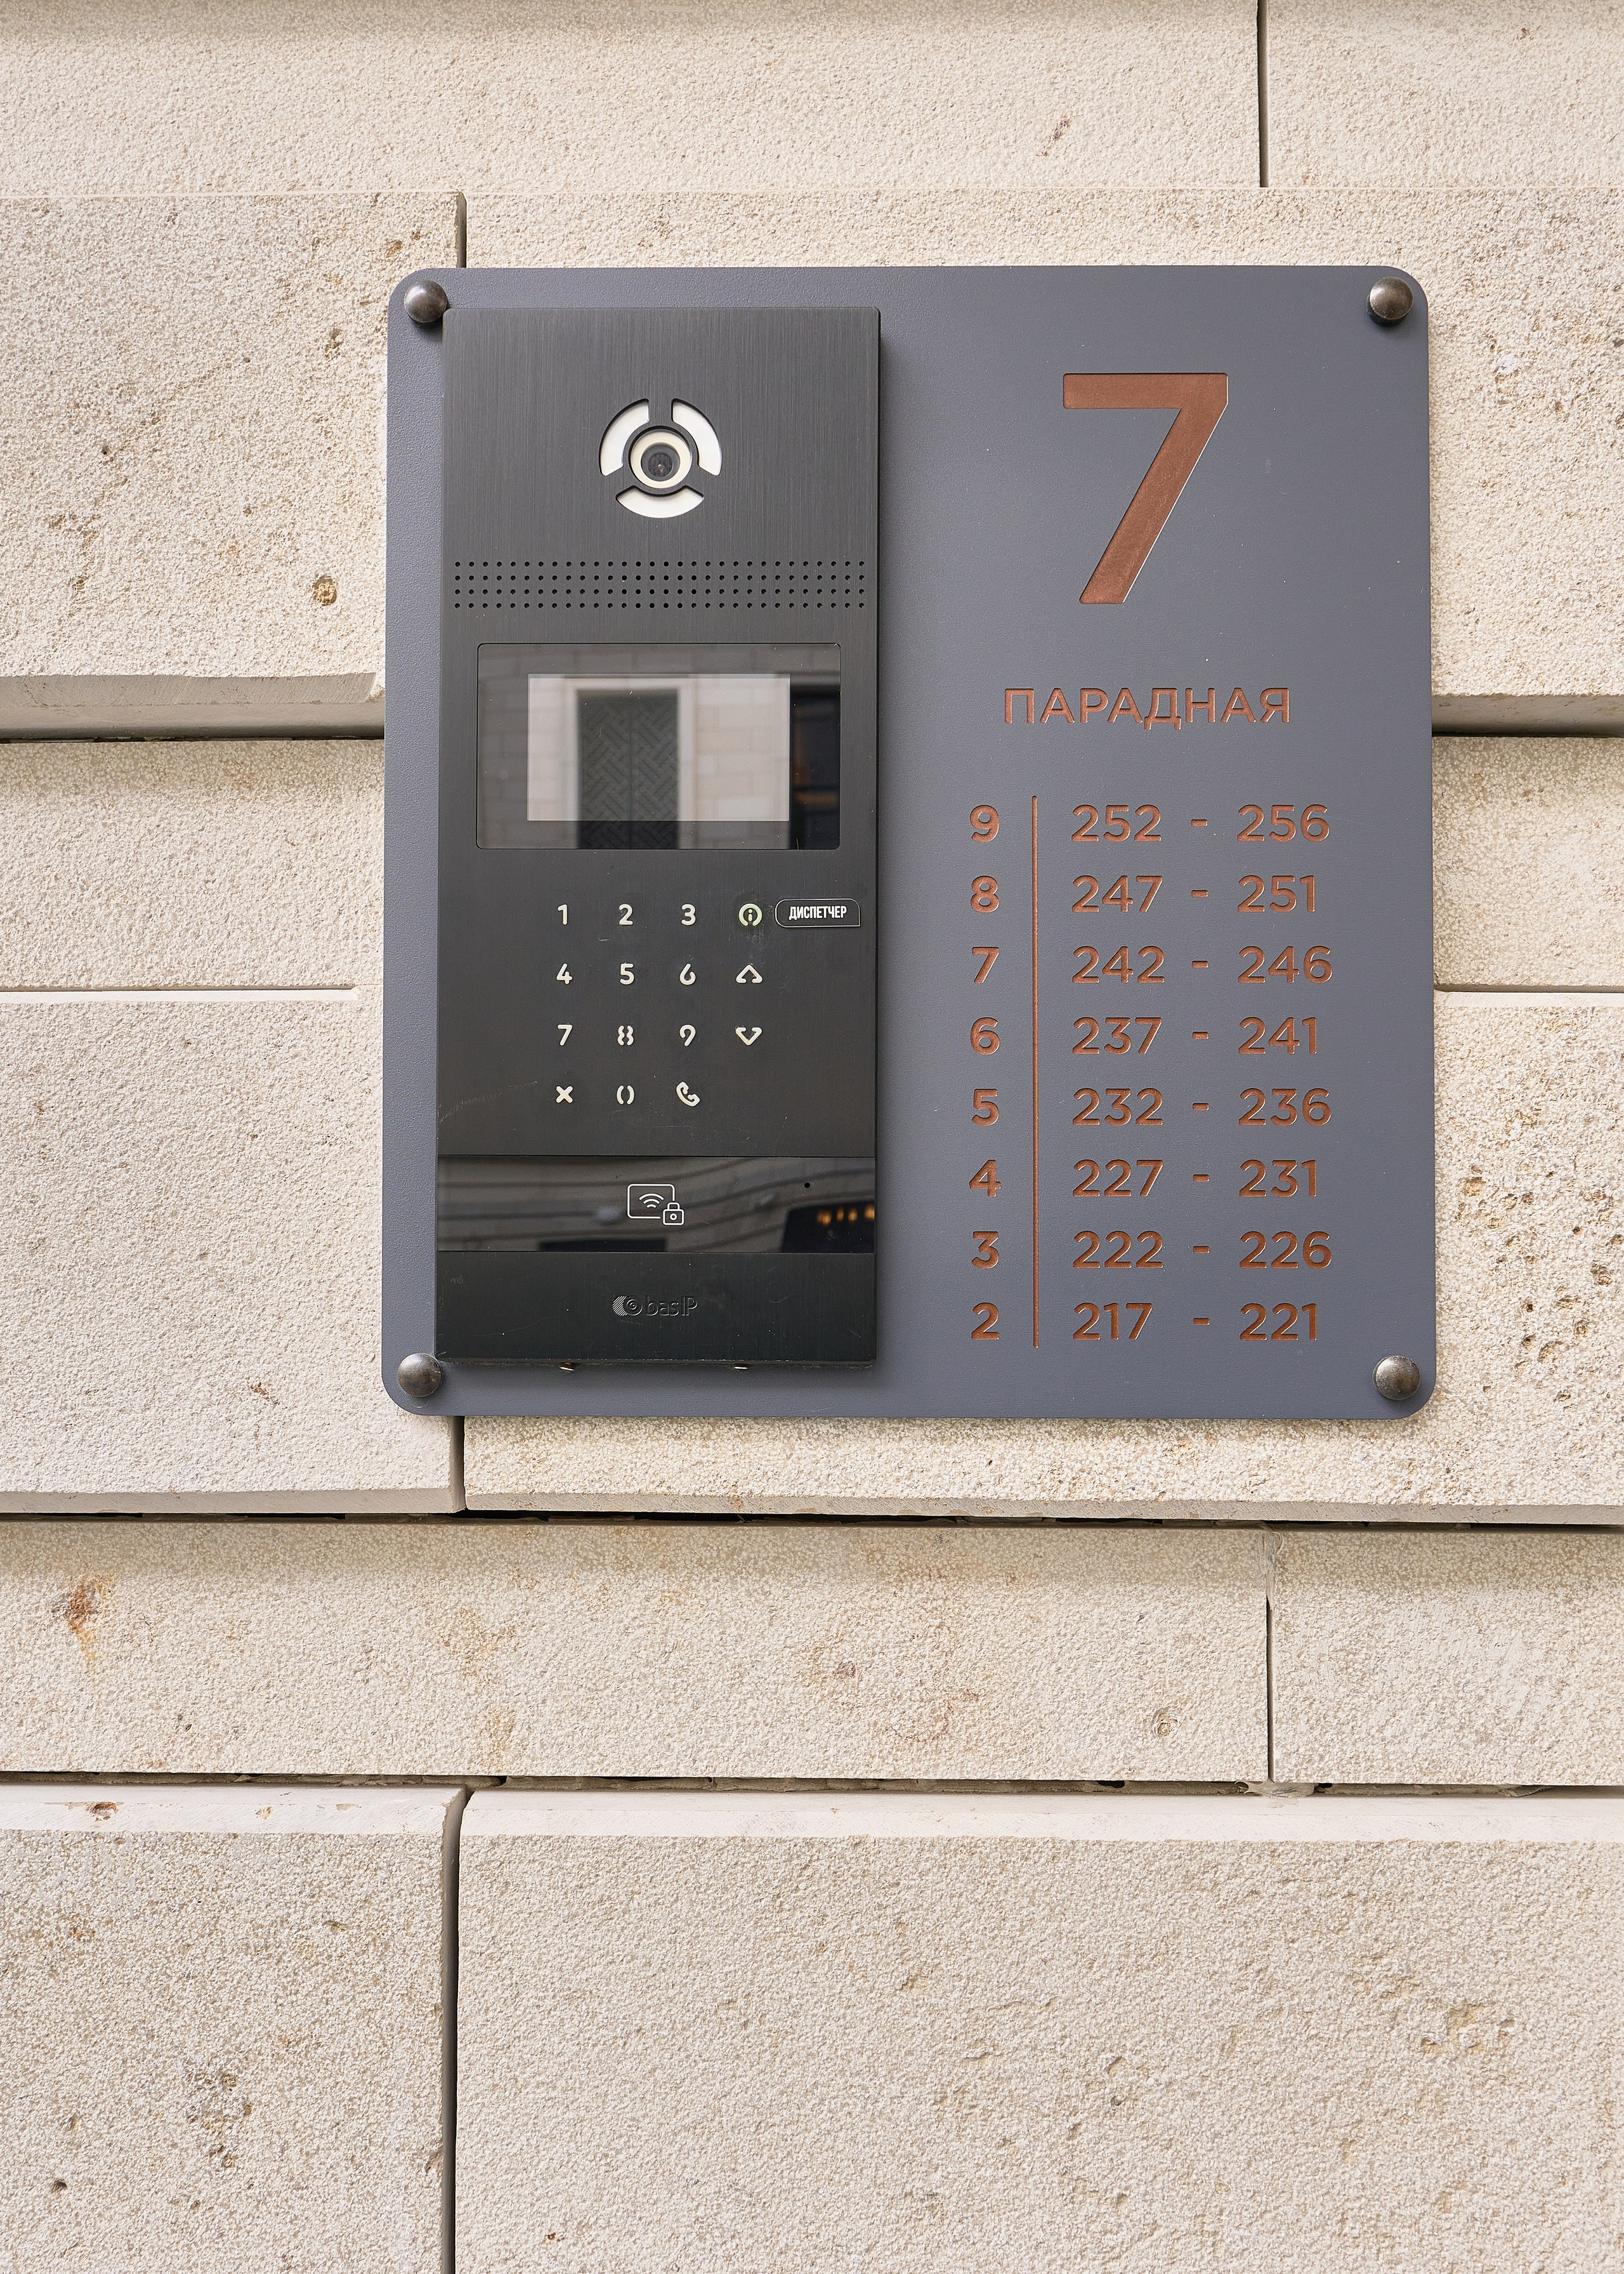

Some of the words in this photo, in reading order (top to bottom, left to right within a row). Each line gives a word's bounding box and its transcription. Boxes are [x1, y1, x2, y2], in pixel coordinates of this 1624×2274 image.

[1063, 372, 1229, 604] 7
[1004, 687, 1290, 731] ПАРАДНАЯ
[970, 805, 1000, 843] 9
[1071, 804, 1162, 842] 252
[1237, 804, 1330, 842] 256
[789, 905, 847, 920] ДИСПЕТЧЕР
[971, 875, 1000, 913] 8
[1072, 875, 1163, 913] 247
[1238, 875, 1316, 913] 251
[557, 904, 568, 925] 1
[619, 904, 634, 925] 2
[681, 904, 696, 925] 3
[556, 963, 573, 984] 4
[620, 963, 634, 985] 5
[679, 963, 696, 985] 6
[971, 946, 1000, 984] 7
[1072, 946, 1165, 984] 242
[1238, 946, 1333, 984] 246
[557, 1024, 573, 1046] 7
[617, 1025, 634, 1046] 8
[679, 1024, 696, 1047] 9
[970, 1017, 1000, 1055] 6
[1072, 1017, 1163, 1055] 237
[1238, 1017, 1318, 1055] 241
[971, 1088, 1000, 1127] 5
[1072, 1088, 1164, 1127] 232
[1238, 1088, 1332, 1127] 236
[969, 1160, 1002, 1198] 4
[1073, 1160, 1164, 1198] 227
[1239, 1160, 1317, 1198] 231
[971, 1231, 999, 1269] 3
[1073, 1231, 1164, 1269] 222
[1239, 1231, 1332, 1269] 226
[645, 1295, 698, 1316] basIP
[971, 1302, 1000, 1341] 2
[1073, 1302, 1153, 1340] 217
[1239, 1303, 1318, 1342] 221
